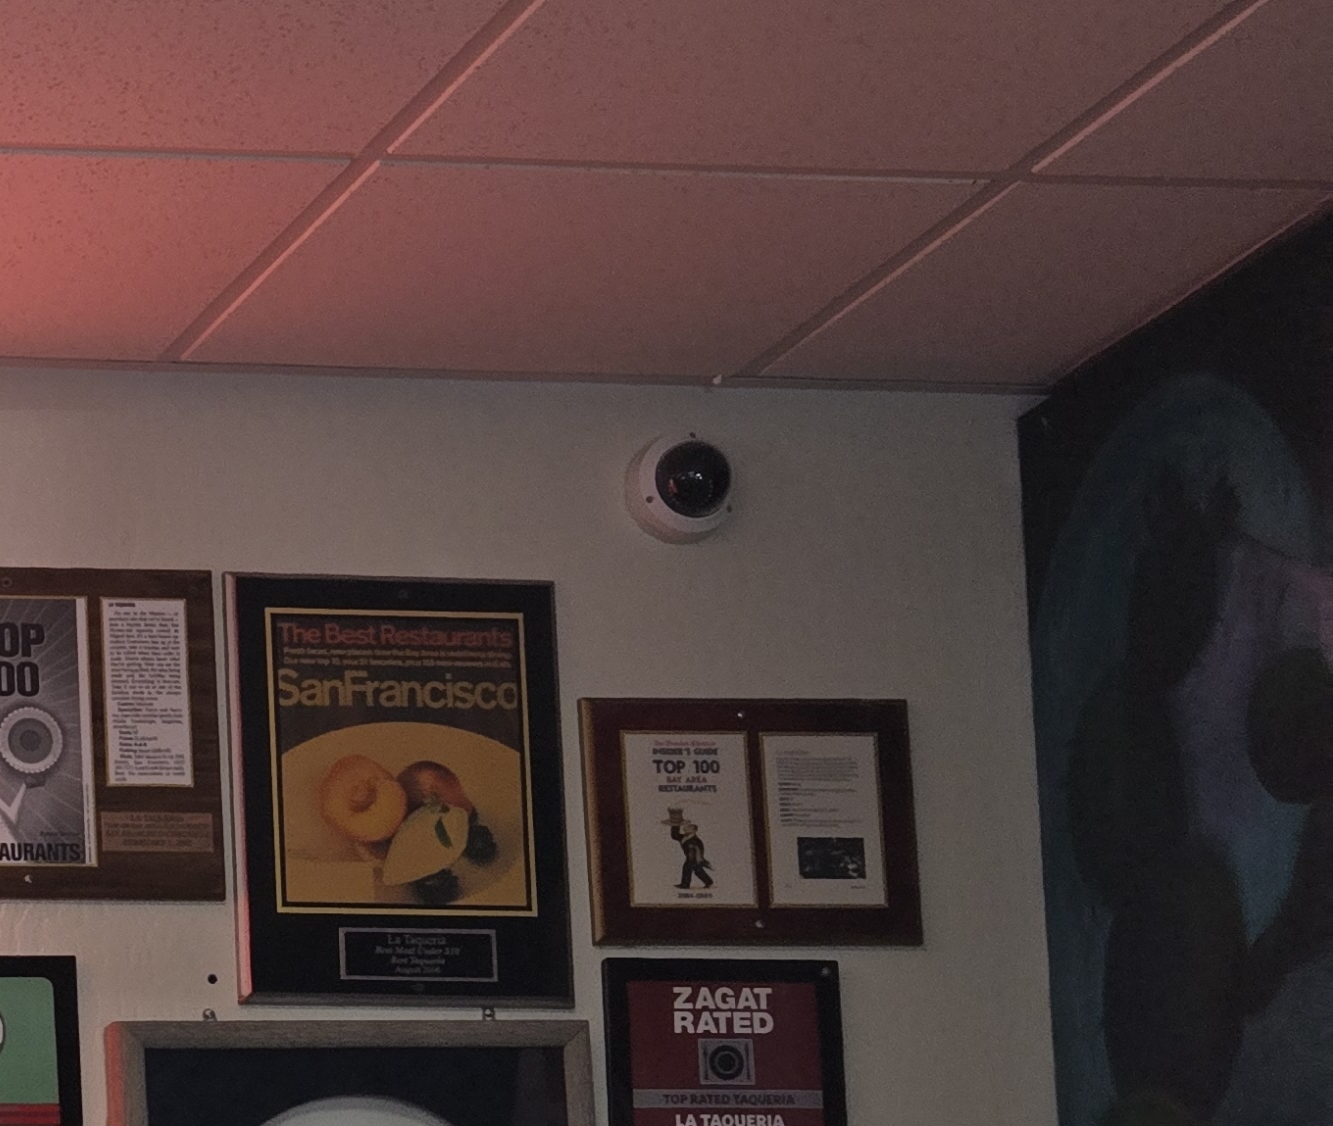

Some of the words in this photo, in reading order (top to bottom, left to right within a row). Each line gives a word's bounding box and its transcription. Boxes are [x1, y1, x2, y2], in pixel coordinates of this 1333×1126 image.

[277, 621, 321, 643] The
[324, 622, 375, 645] Best
[379, 624, 512, 648] Restaurants
[652, 759, 686, 774] TOP
[693, 759, 721, 774] 100
[666, 775, 682, 783] BAY
[658, 784, 717, 793] RESTAURANTS
[672, 986, 773, 1010] ZAGAT
[673, 1011, 775, 1034] RATED
[662, 1093, 690, 1105] TOP
[690, 1094, 731, 1105] RATED
[734, 1093, 796, 1106] TAQUERIA
